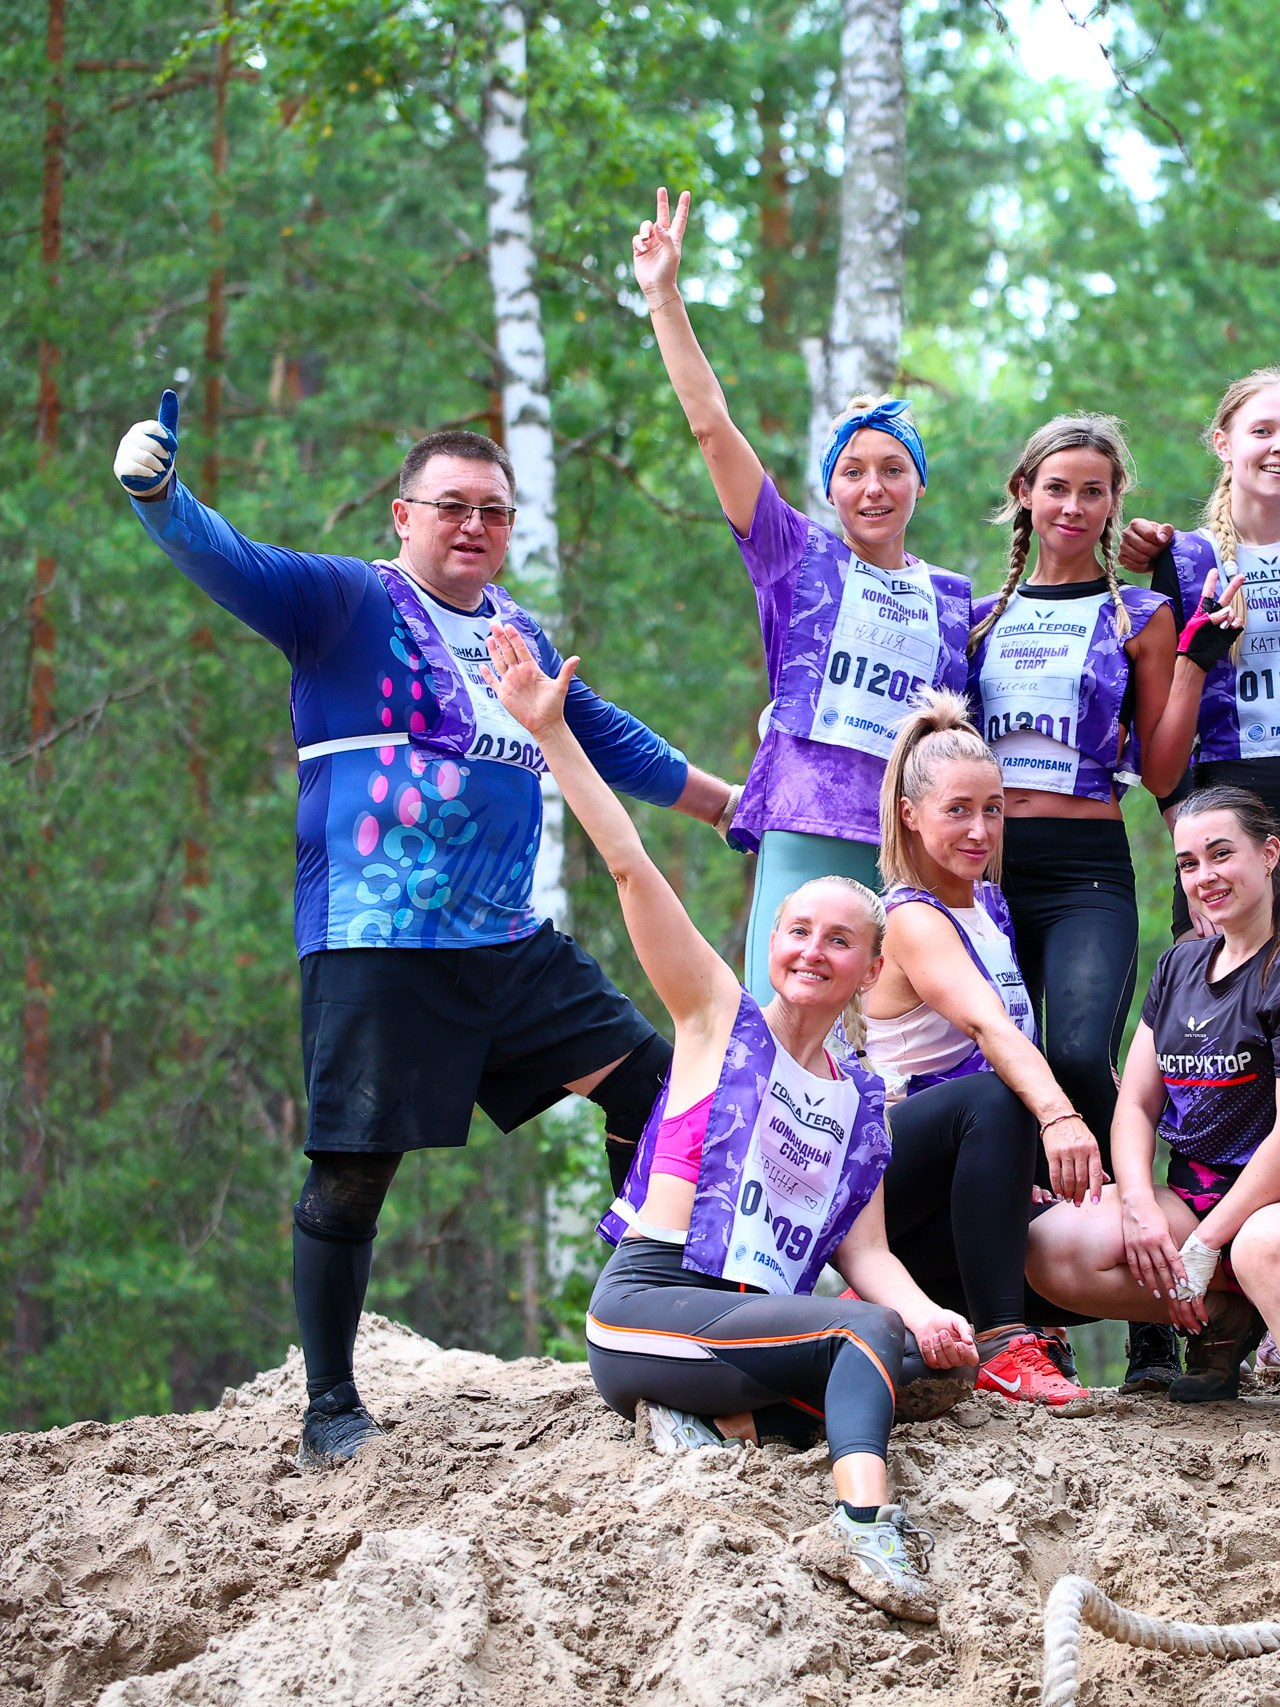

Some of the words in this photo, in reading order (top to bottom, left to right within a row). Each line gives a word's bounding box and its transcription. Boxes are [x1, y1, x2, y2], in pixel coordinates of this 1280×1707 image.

[862, 588, 929, 622] КОМАНДНЫЙ
[878, 606, 910, 626] СТАРТ
[997, 622, 1035, 635] ГОНКА
[1038, 622, 1087, 634] ГЕРОЕВ
[1000, 645, 1069, 659] КОМАНДНЫЙ
[1014, 659, 1048, 670] СТАРТ
[844, 715, 898, 740] ГАЗПРОМБ
[1002, 757, 1073, 773] ГАЗПРОМБАНК
[805, 1112, 845, 1140] ГЕРОЕВ
[769, 1116, 832, 1168] КОМАНДНЫЙ
[779, 1142, 810, 1171] СТАРТ
[741, 1180, 813, 1261] 009
